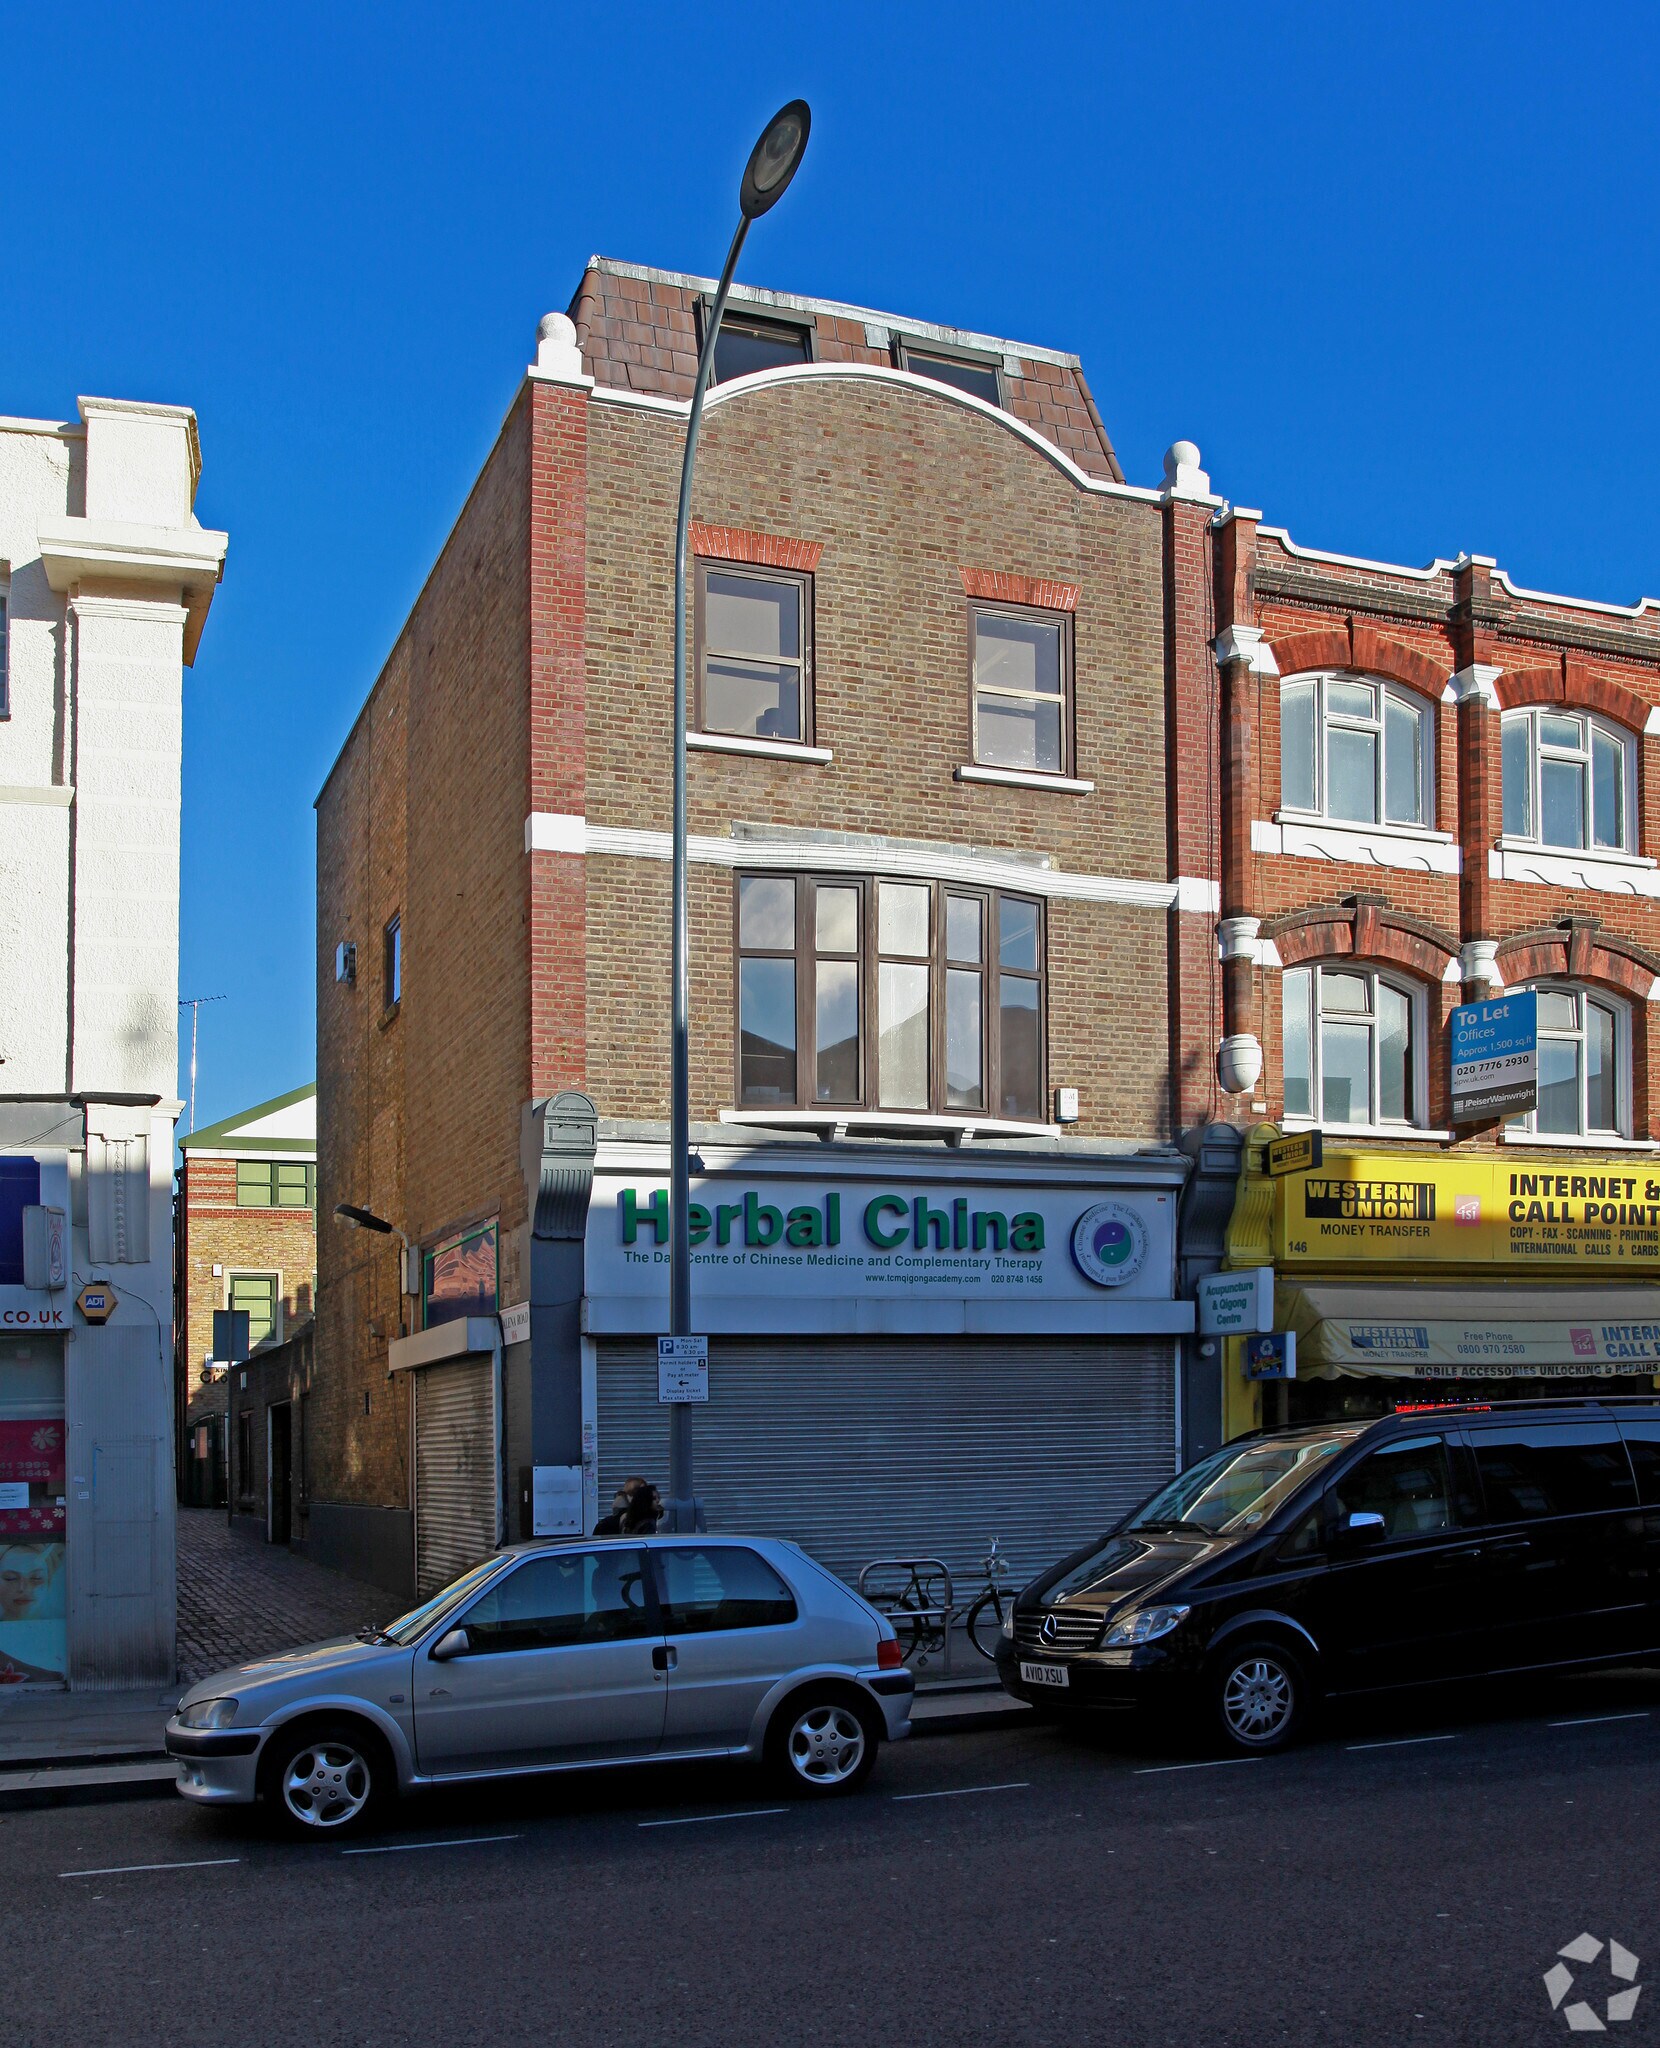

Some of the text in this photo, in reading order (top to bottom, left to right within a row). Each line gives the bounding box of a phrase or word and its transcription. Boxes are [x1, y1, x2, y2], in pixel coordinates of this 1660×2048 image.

[1458, 1004, 1509, 1026] To Let
[1458, 1027, 1495, 1042] Offices
[1458, 1036, 1532, 1058] Approx 1,500 sq.ft
[1457, 1055, 1529, 1076] 020 7776 2930
[1465, 1089, 1534, 1108] JPeiserWainwright
[1307, 1181, 1414, 1200] WESTERN
[1510, 1174, 1660, 1200] INTERNET &
[1113, 1204, 1123, 1212] The
[1126, 1209, 1143, 1228] London
[1341, 1201, 1414, 1218] UNION
[1509, 1200, 1660, 1226] CALL POINT
[617, 1188, 1046, 1250] Herbal China
[1321, 1224, 1430, 1237] MONEY TRANSFER
[1510, 1227, 1533, 1238] COPY
[1542, 1228, 1558, 1238] FAX
[1567, 1228, 1611, 1240] SCANNING
[1620, 1230, 1658, 1241] PRINTING
[1288, 1242, 1307, 1253] 146
[1510, 1242, 1658, 1256] INTERNATIONAL CALLS & CARDS
[624, 1251, 649, 1262] The
[654, 1252, 670, 1262] Da
[733, 1253, 746, 1264] of
[750, 1253, 802, 1264] Chinese
[807, 1254, 863, 1266] Medicine
[868, 1256, 890, 1266] and
[895, 1256, 990, 1270] Complementary
[995, 1257, 1042, 1270] Therapy
[866, 1274, 1042, 1284] www.tcmqigongacademy.com 020 8748 1456
[1206, 1282, 1253, 1296] Acupuncture
[86, 1297, 104, 1306] ADT
[1212, 1298, 1246, 1311] & Qigong
[1217, 1314, 1241, 1325] Centre
[1351, 1328, 1415, 1338] WESTERN
[1464, 1332, 1512, 1341] Free Phone
[663, 1341, 672, 1353] P
[1372, 1338, 1416, 1348] UNION
[1458, 1345, 1525, 1354] 0800 970 2580
[1606, 1343, 1650, 1358] CALL
[1415, 1363, 1658, 1376] MOBILE ACCESSORIES UNLOCKING & REPAIRS
[200, 1371, 228, 1383] CLO
[1025, 1665, 1062, 1683] AV10 XSU
